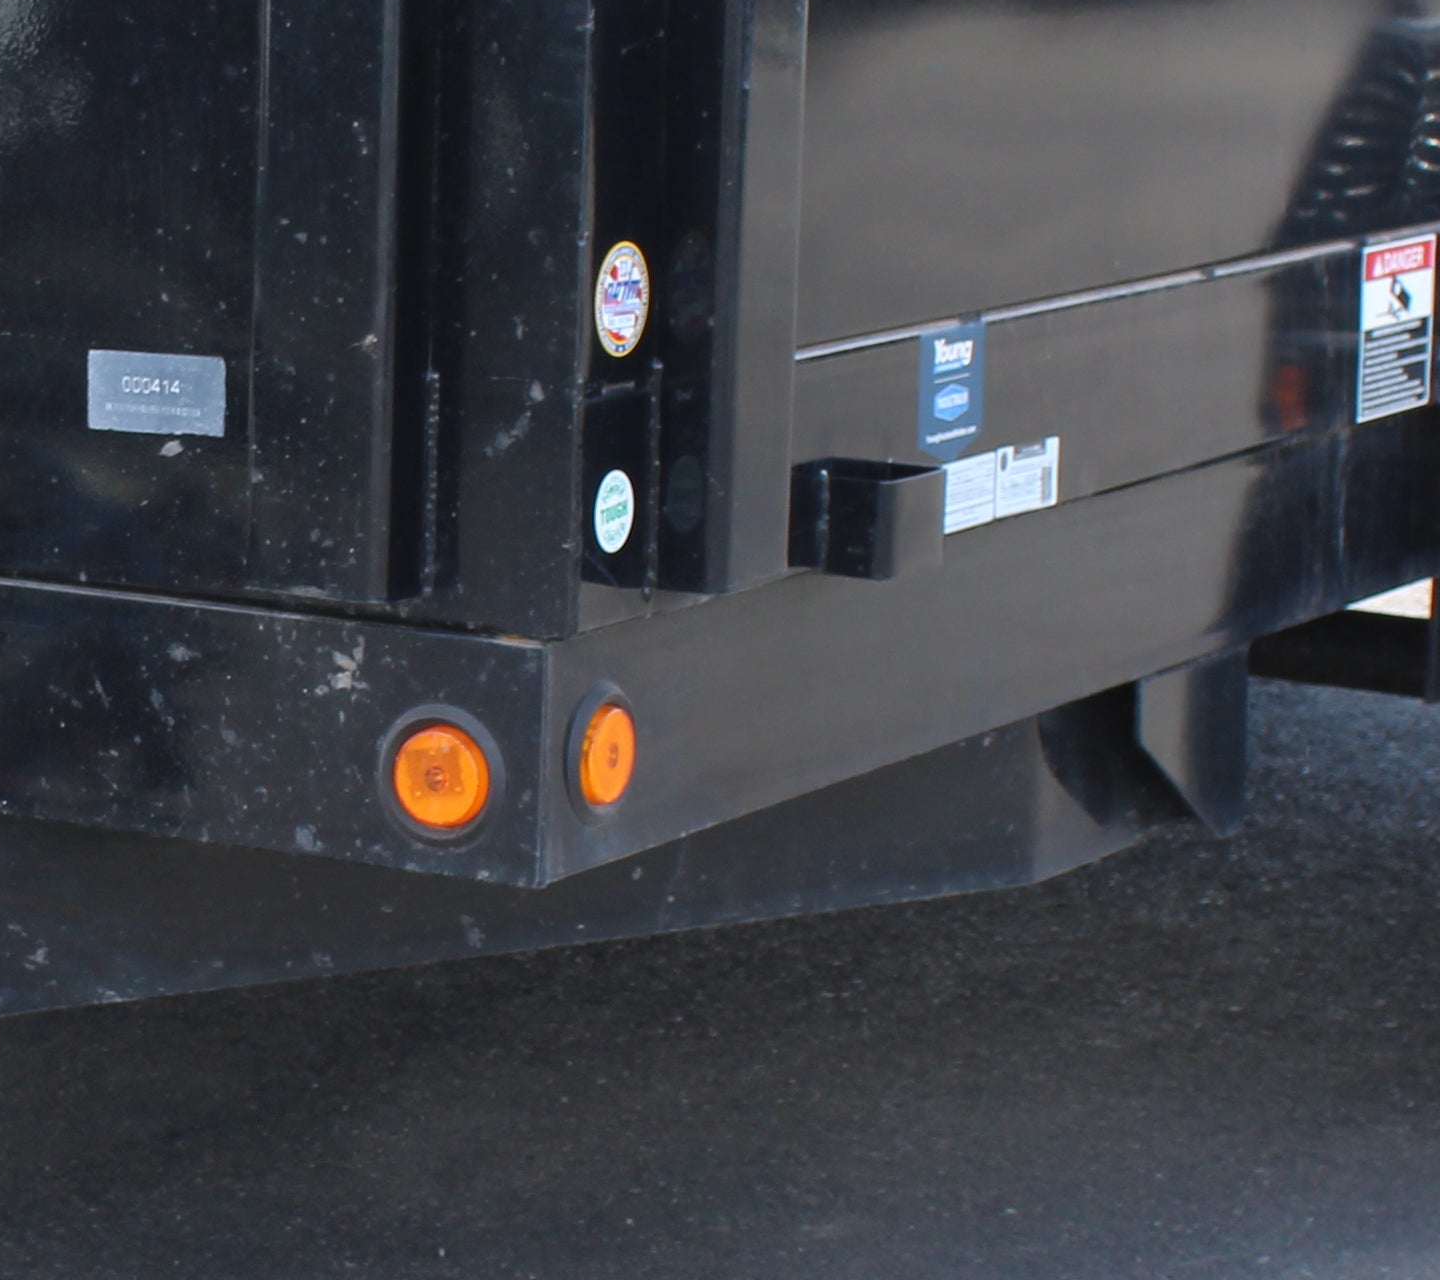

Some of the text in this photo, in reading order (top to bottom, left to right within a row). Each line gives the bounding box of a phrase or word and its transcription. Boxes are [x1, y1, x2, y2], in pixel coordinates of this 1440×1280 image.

[1384, 246, 1423, 272] DANGER
[933, 338, 974, 366] Young
[121, 375, 181, 396] 000414
